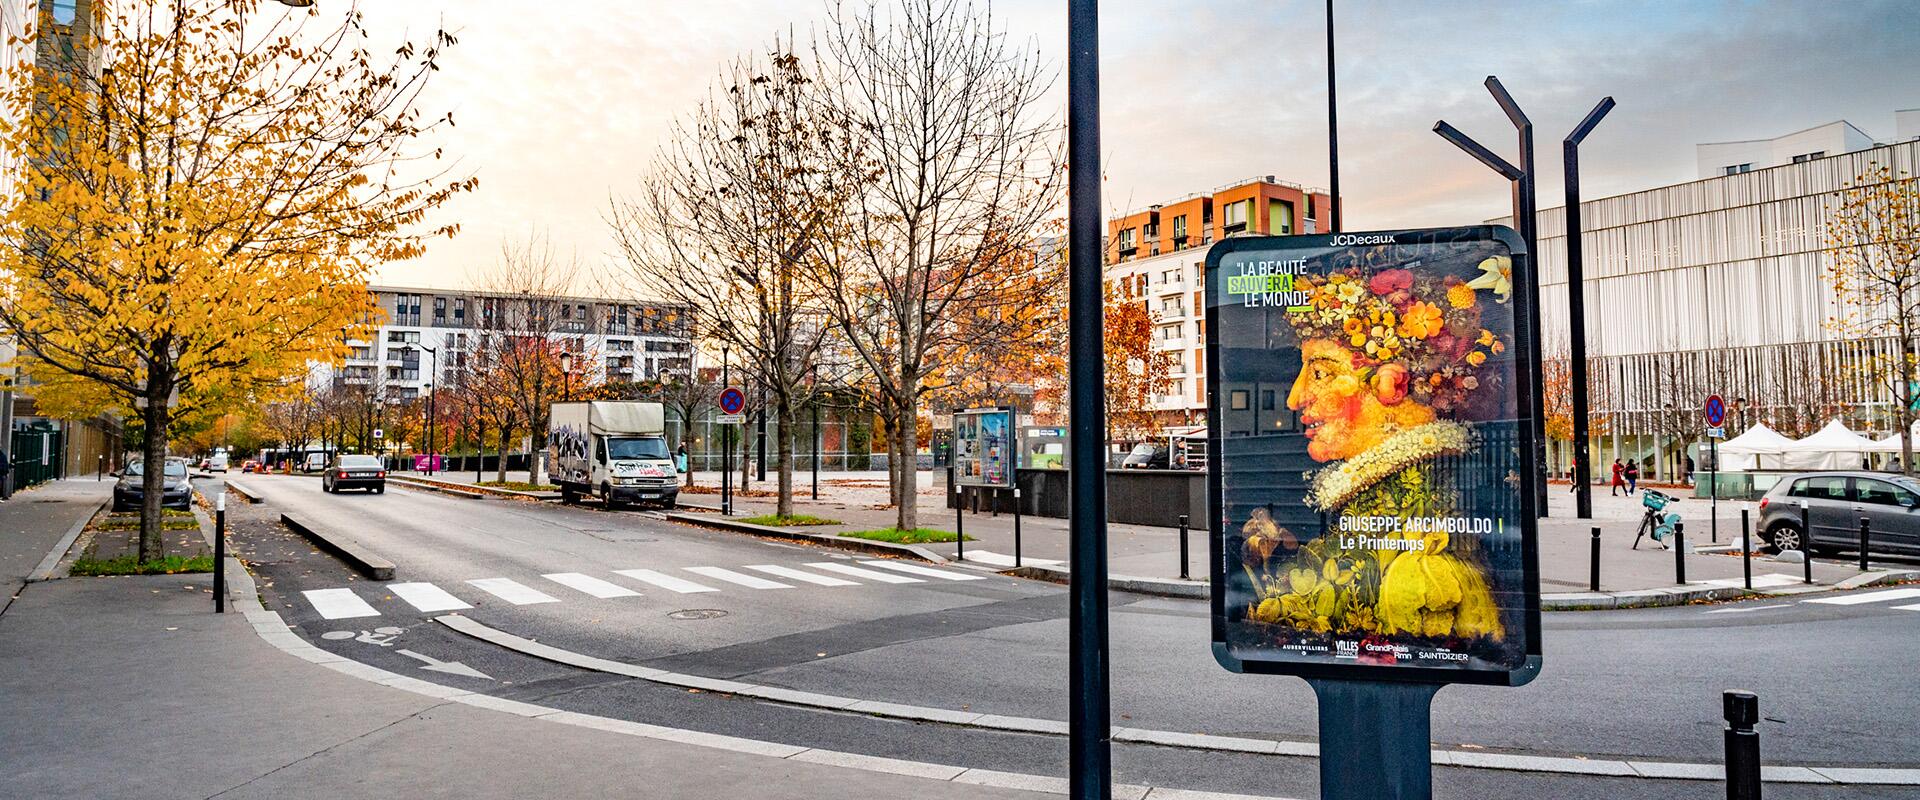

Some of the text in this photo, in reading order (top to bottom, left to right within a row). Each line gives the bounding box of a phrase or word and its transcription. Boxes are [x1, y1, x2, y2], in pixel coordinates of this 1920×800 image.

[1329, 234, 1396, 247] JCDecaux
[1259, 256, 1308, 276] BEAUTÉ
[1230, 276, 1290, 292] SAUVERA
[1244, 290, 1311, 307] LE MONDE
[1338, 516, 1492, 534] GIUSEPPE ARCIMBOLDO
[1339, 534, 1425, 554] Le Printemps
[1282, 644, 1328, 652] AUBERVILLIERS
[1335, 640, 1359, 651] VILLES
[1366, 643, 1409, 653] GrandPalais
[1394, 651, 1412, 659] Rmn
[1418, 651, 1469, 661] SAINTDIZIER
